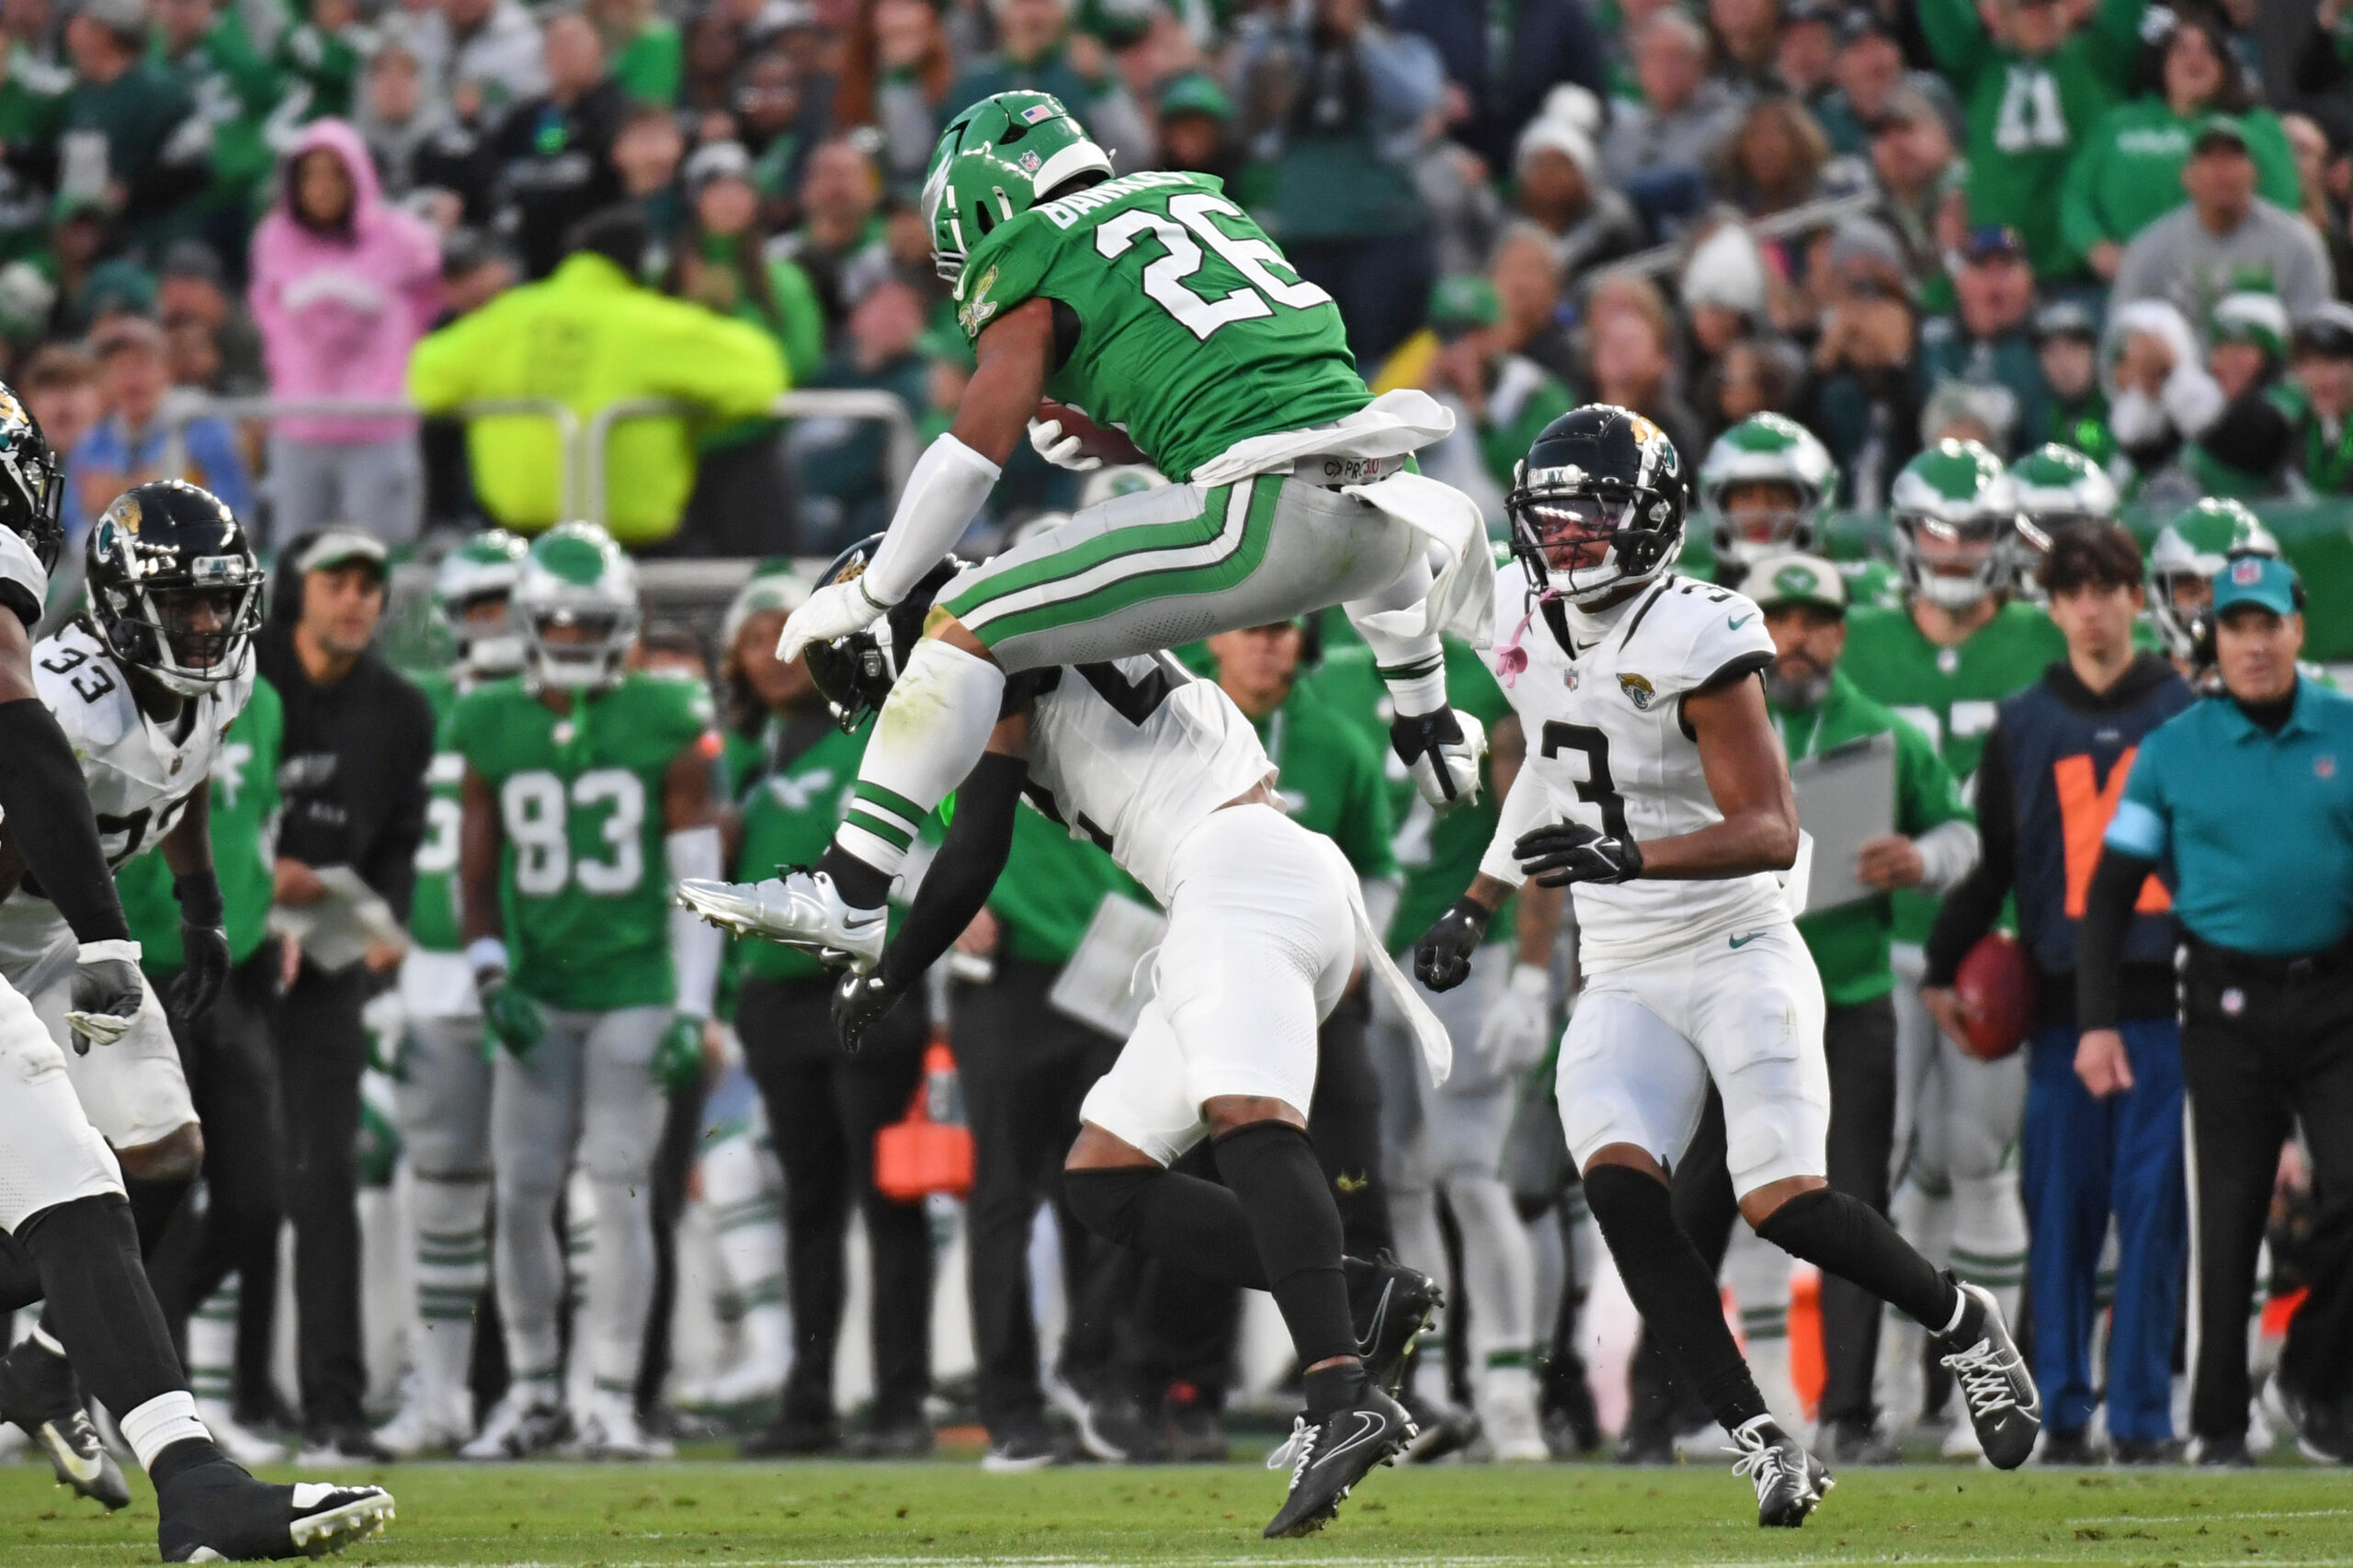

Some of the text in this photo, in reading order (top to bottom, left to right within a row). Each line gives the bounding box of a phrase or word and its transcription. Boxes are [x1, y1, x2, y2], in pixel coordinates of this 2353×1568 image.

[1094, 191, 1334, 344] 26
[40, 647, 116, 704] 33
[502, 769, 644, 892] 83
[1540, 720, 1630, 842] 3
